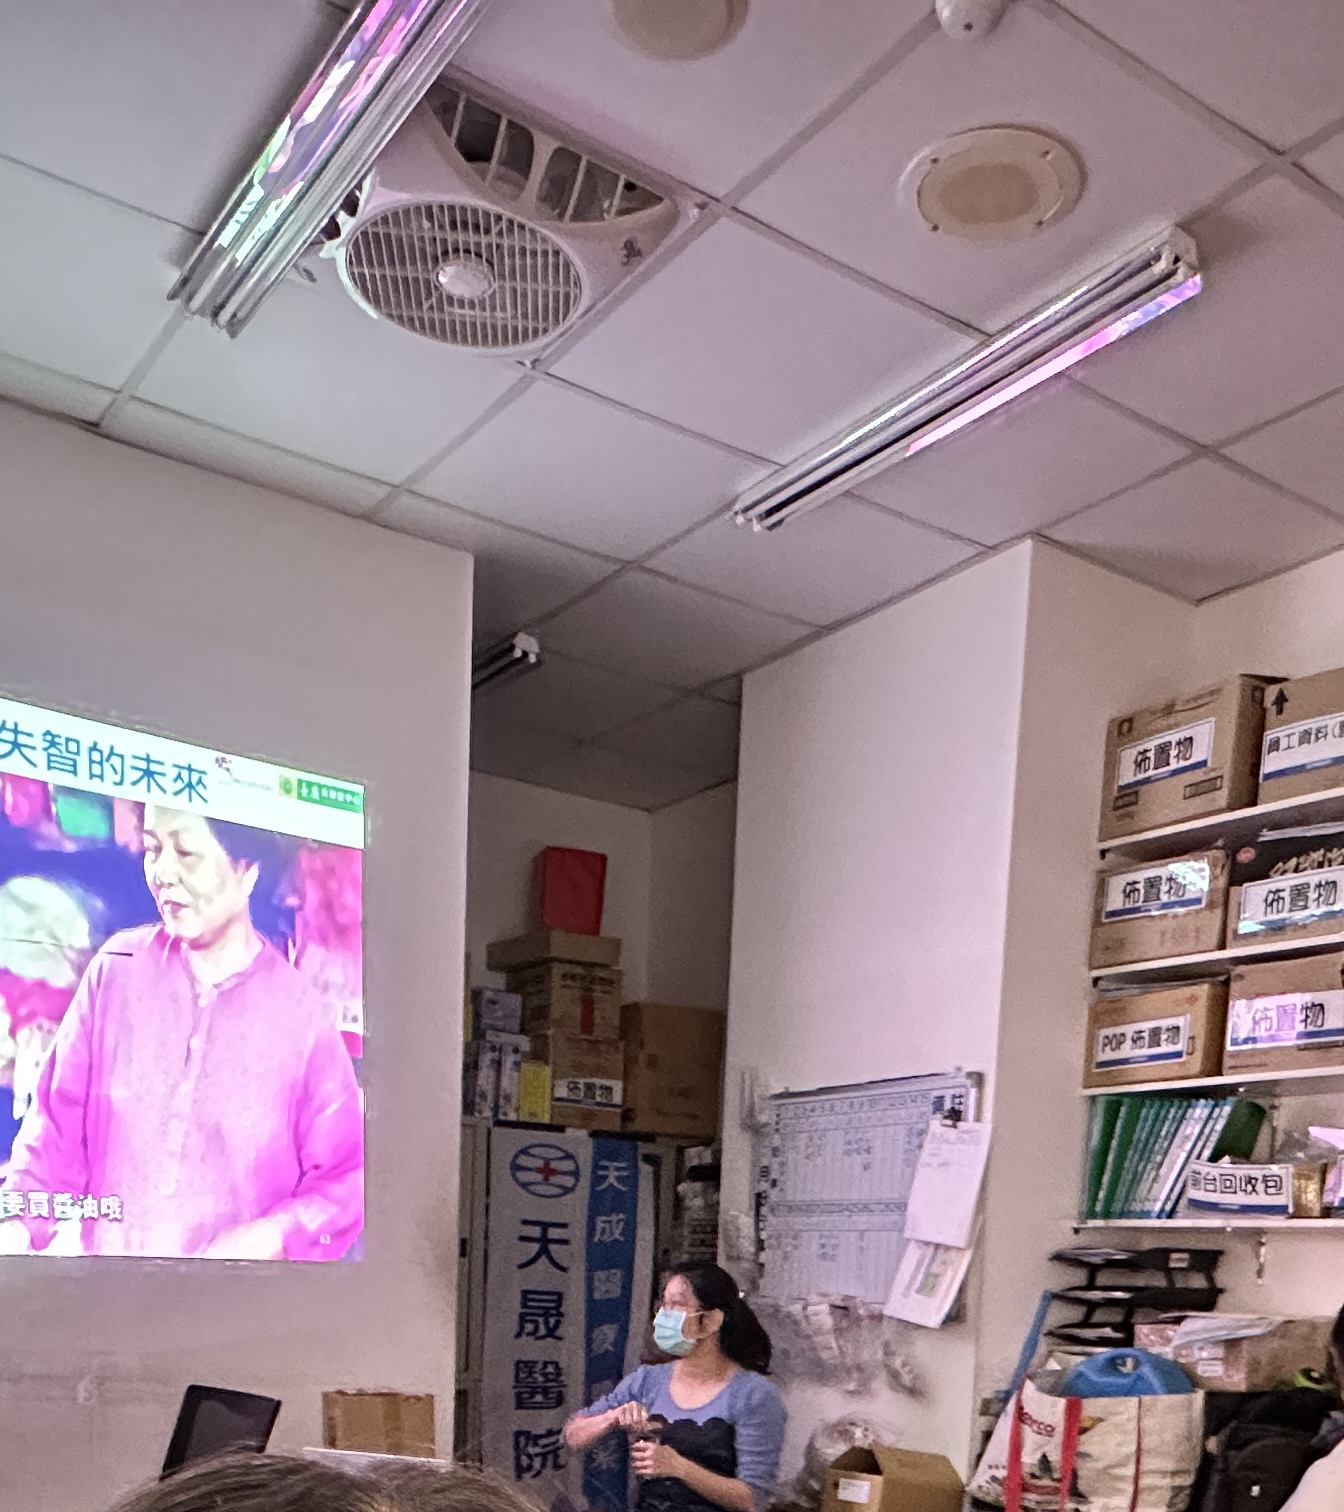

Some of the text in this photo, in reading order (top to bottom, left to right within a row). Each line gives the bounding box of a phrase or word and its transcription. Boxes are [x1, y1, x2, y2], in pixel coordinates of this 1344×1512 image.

[1133, 734, 1195, 778] 佈置物
[1122, 872, 1186, 907] 佈置物
[1263, 880, 1339, 917] 佈置物
[1251, 1000, 1325, 1034] 佈置物
[1102, 1024, 1181, 1054] POP 佈置物
[512, 1219, 570, 1481] 天晟醫院
